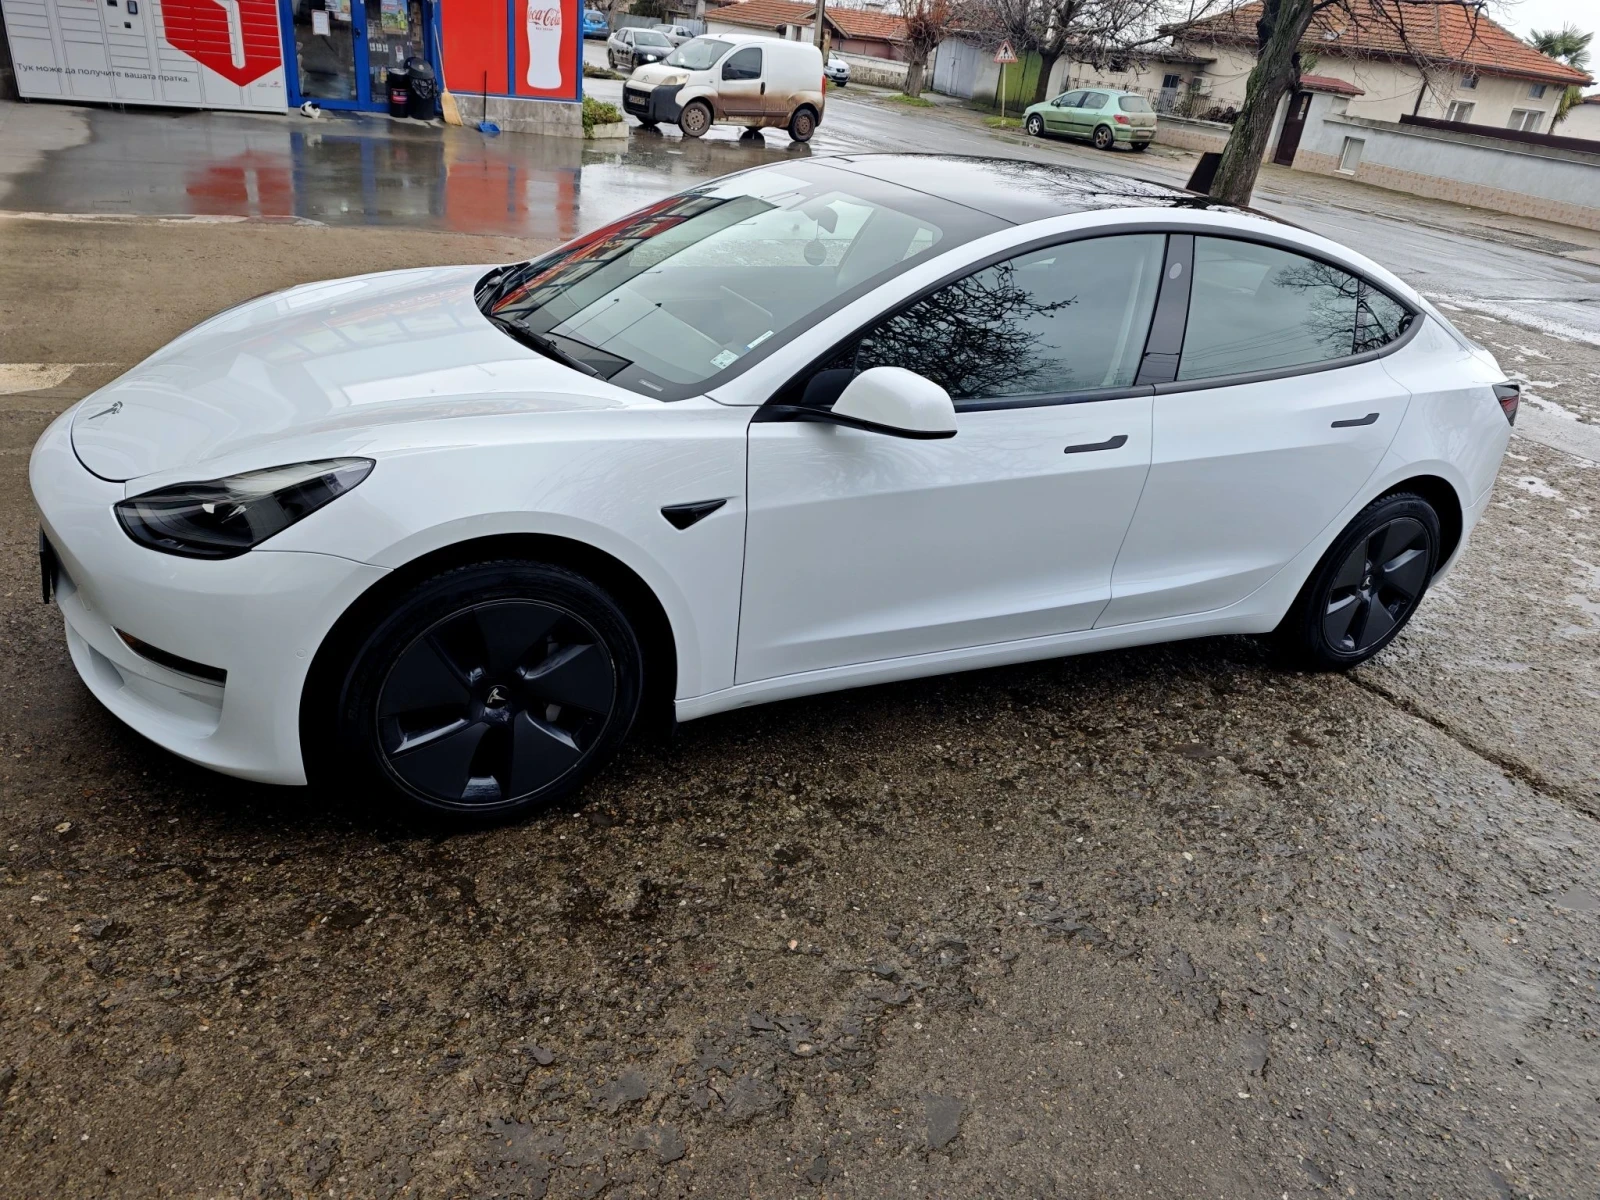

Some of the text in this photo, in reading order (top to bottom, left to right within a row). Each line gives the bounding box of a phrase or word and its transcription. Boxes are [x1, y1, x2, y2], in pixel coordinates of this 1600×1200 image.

[16, 62, 34, 72] Тук
[36, 65, 63, 73] може
[65, 67, 76, 75] да
[78, 68, 122, 77] получите
[124, 72, 157, 80] вашата
